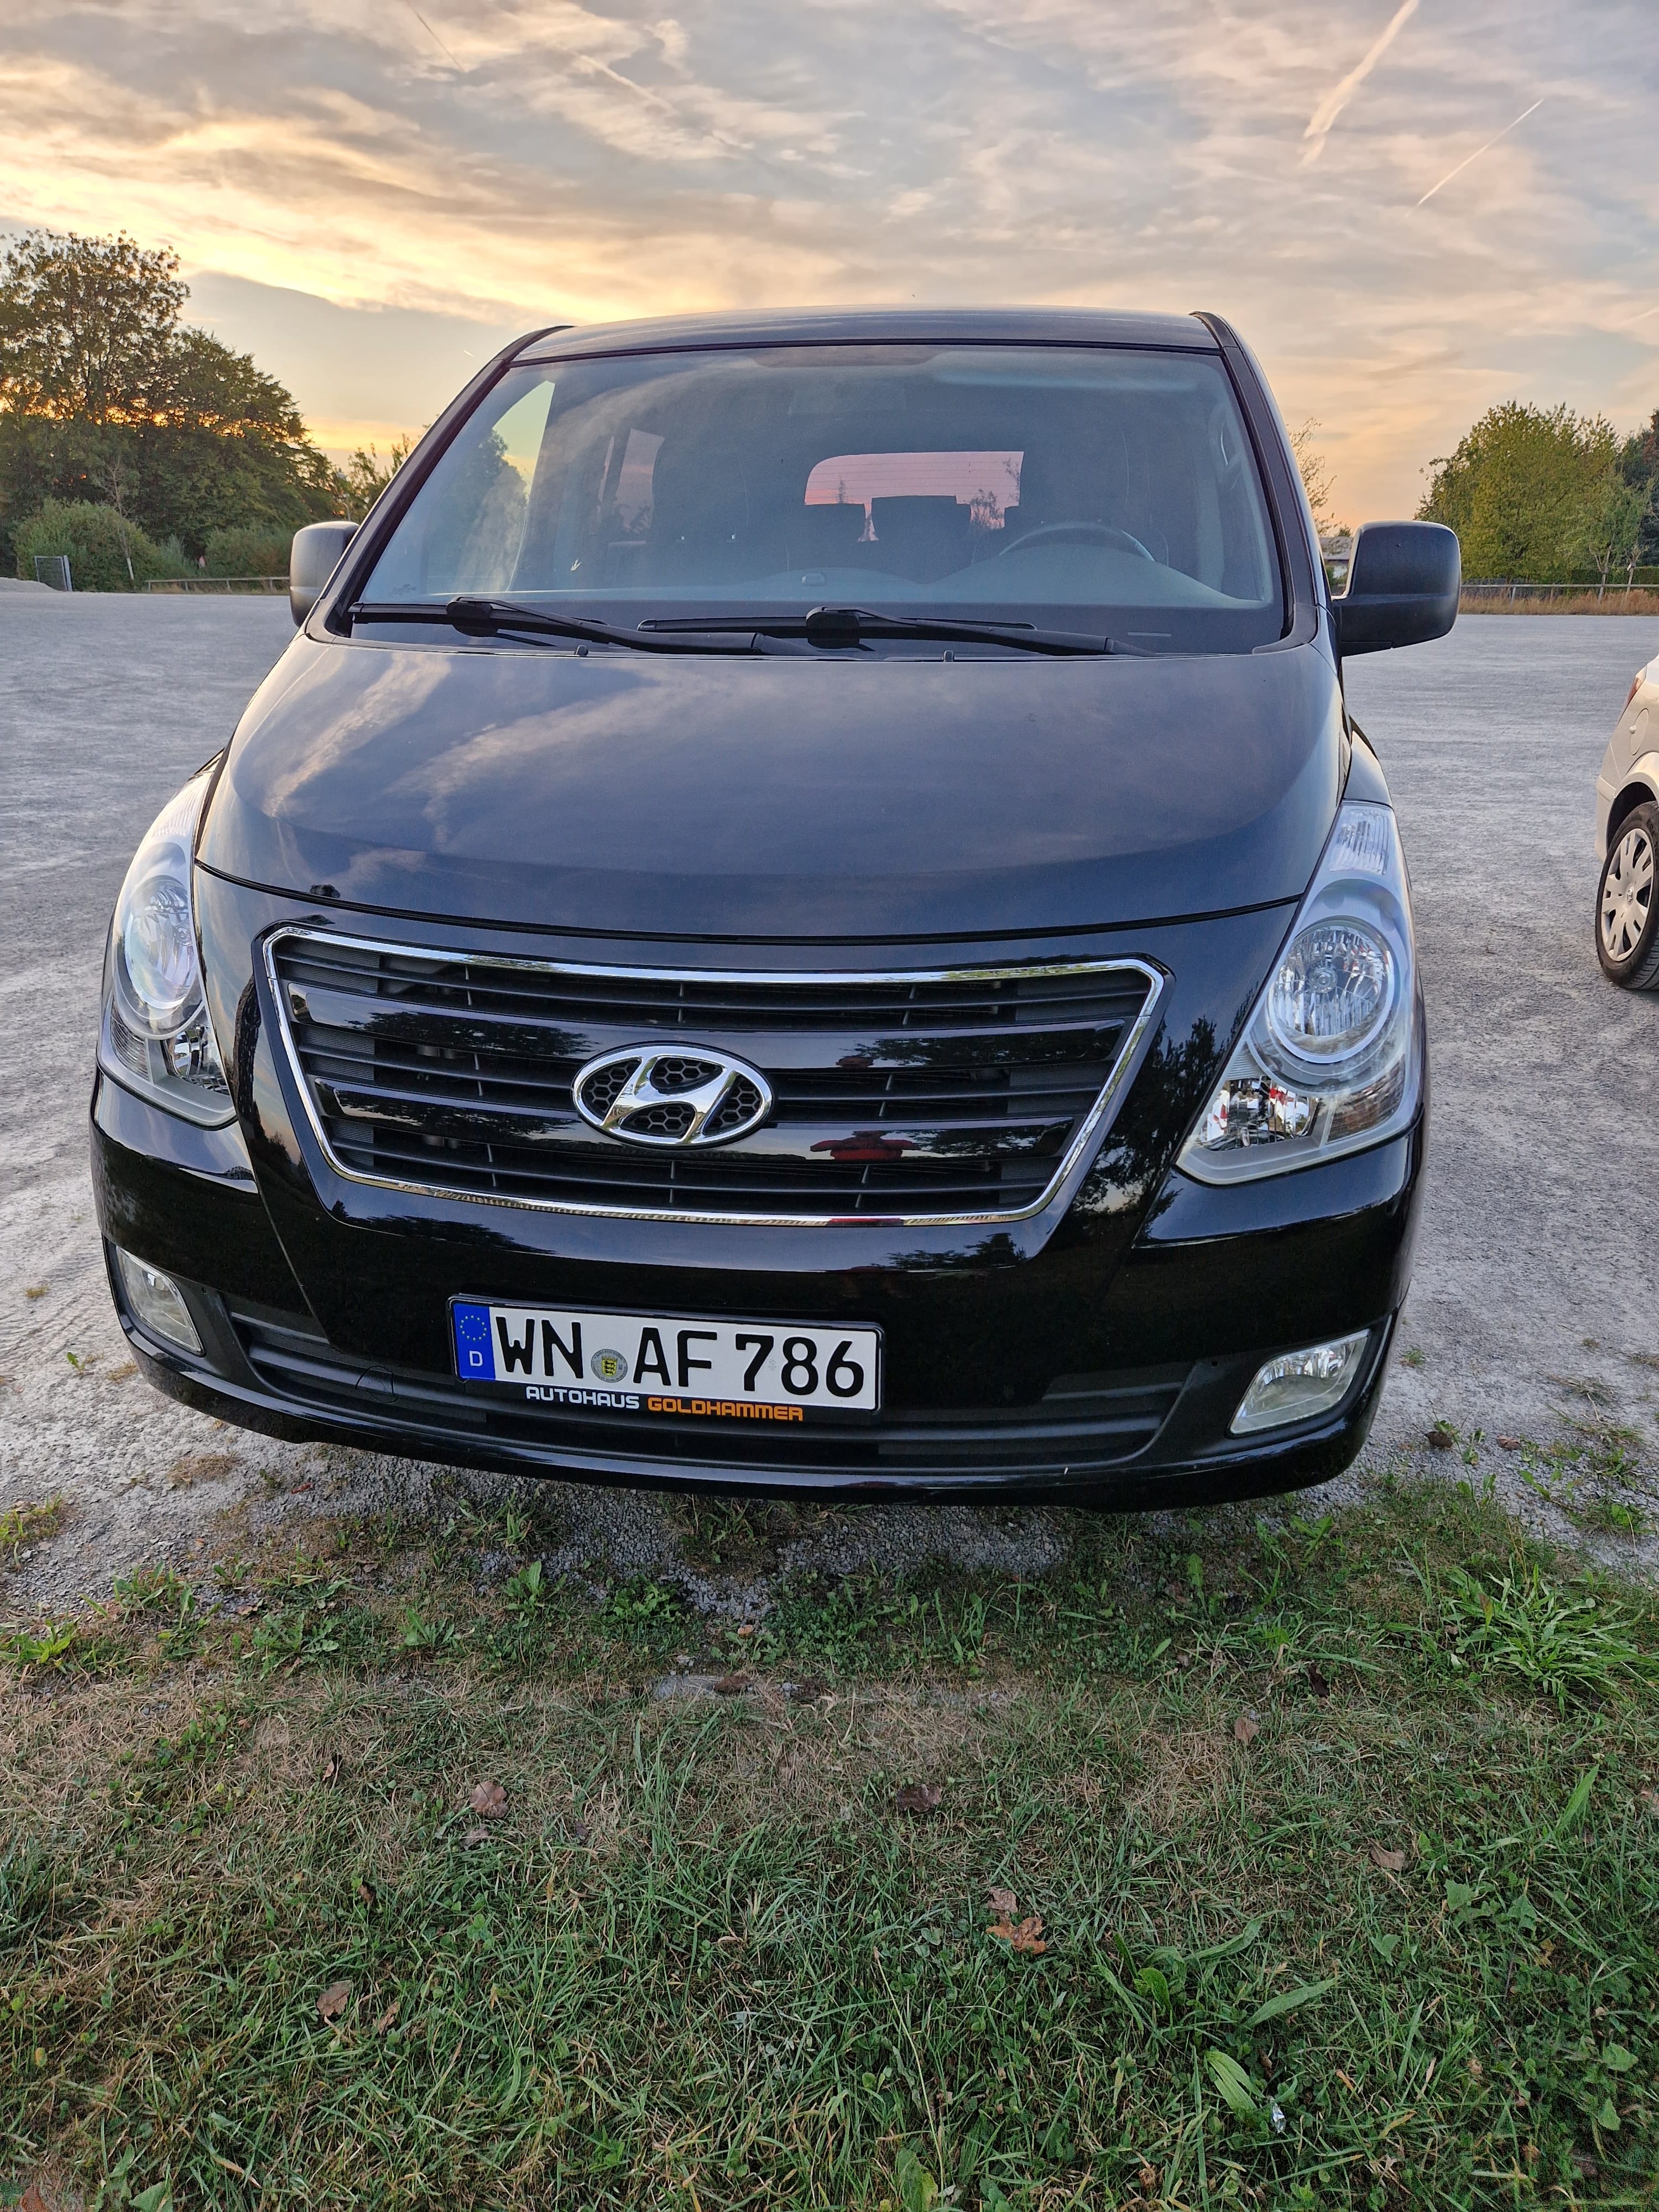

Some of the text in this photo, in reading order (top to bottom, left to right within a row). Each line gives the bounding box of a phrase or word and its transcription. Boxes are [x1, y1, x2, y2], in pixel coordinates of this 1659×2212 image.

[469, 1350, 483, 1367] D
[495, 1316, 584, 1379] WN
[633, 1327, 718, 1387] AF
[735, 1333, 864, 1397] 786
[526, 1386, 804, 1422] AUTOHAUS GOLDHAMMER
